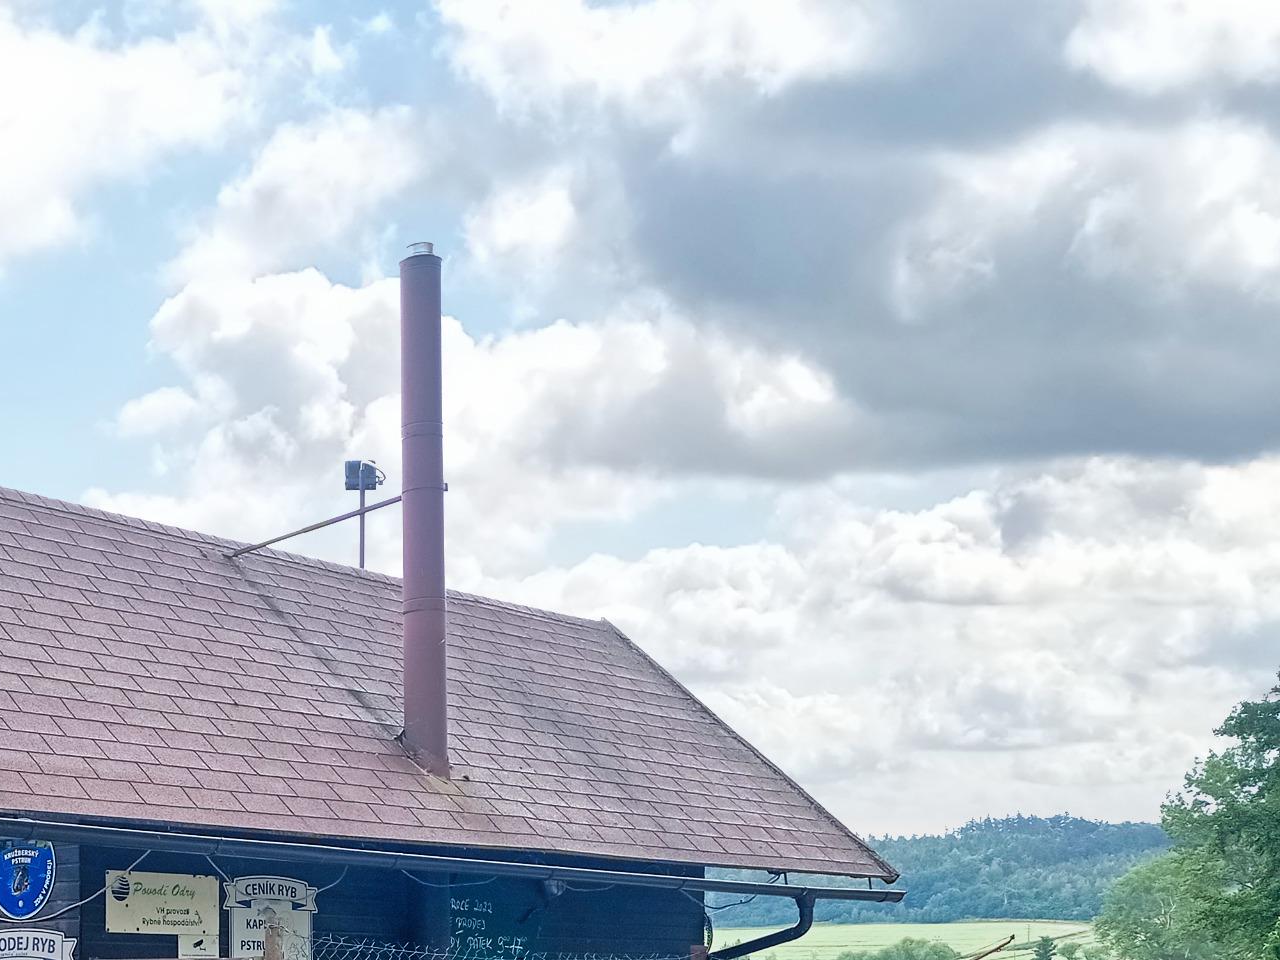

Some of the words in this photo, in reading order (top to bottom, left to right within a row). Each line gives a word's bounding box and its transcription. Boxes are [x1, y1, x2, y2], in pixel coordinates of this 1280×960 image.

[133, 882, 169, 896] Povodí
[171, 884, 196, 899] Odry
[245, 881, 276, 896] CENÍK
[278, 884, 297, 898] RYB
[142, 917, 161, 926] Rybné
[32, 936, 56, 954] RYB
